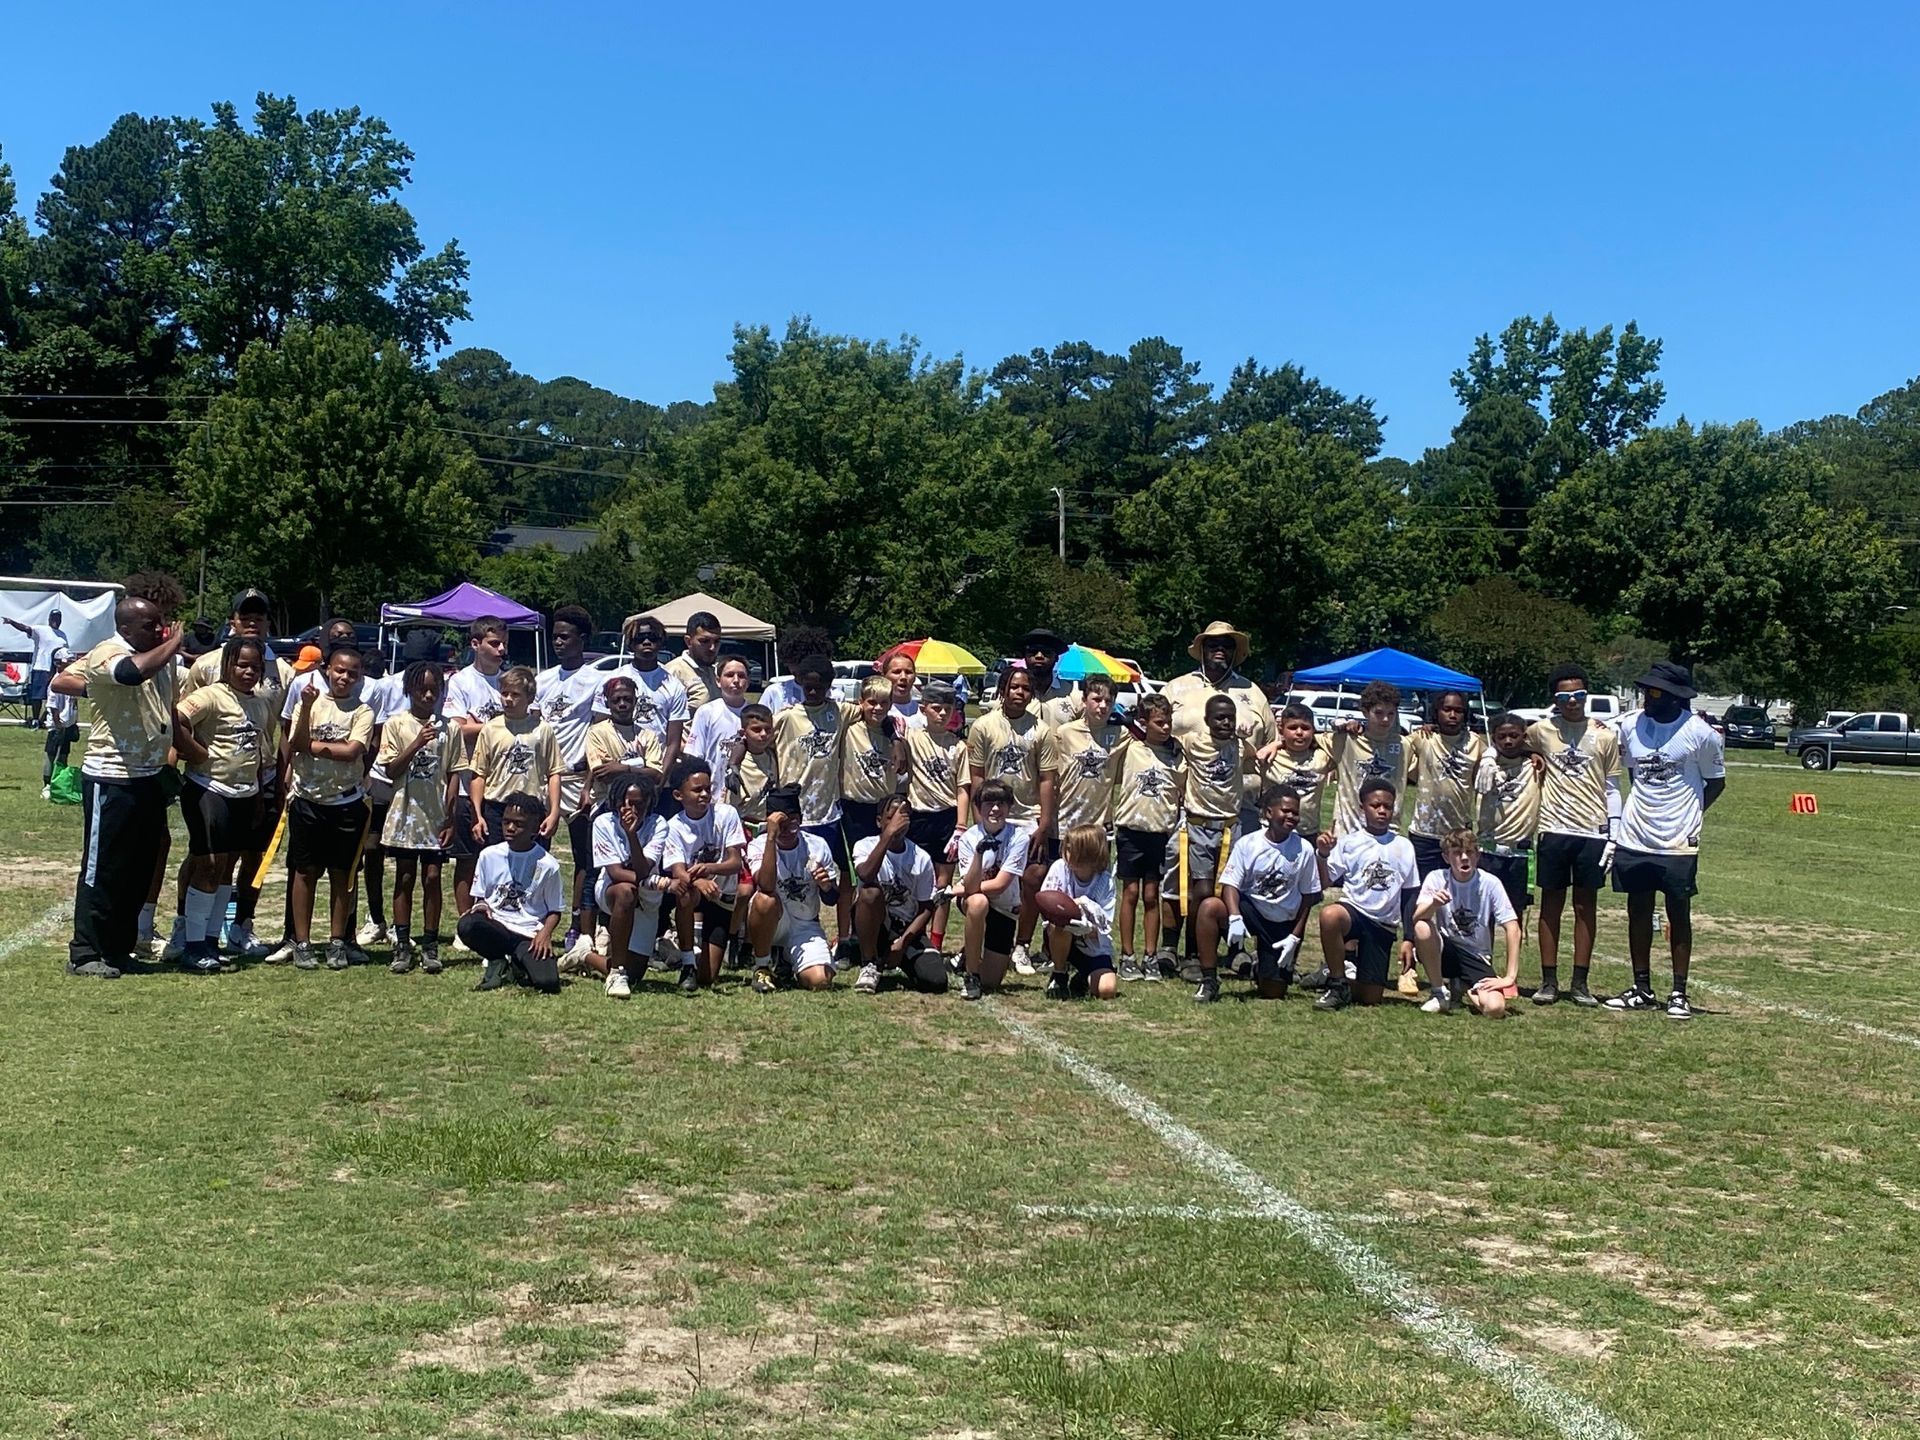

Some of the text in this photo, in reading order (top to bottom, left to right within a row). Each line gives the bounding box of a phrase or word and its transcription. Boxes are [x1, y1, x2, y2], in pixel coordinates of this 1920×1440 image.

[1105, 734, 1116, 746] 17
[1388, 743, 1401, 754] 33
[1798, 796, 1816, 813] 10
